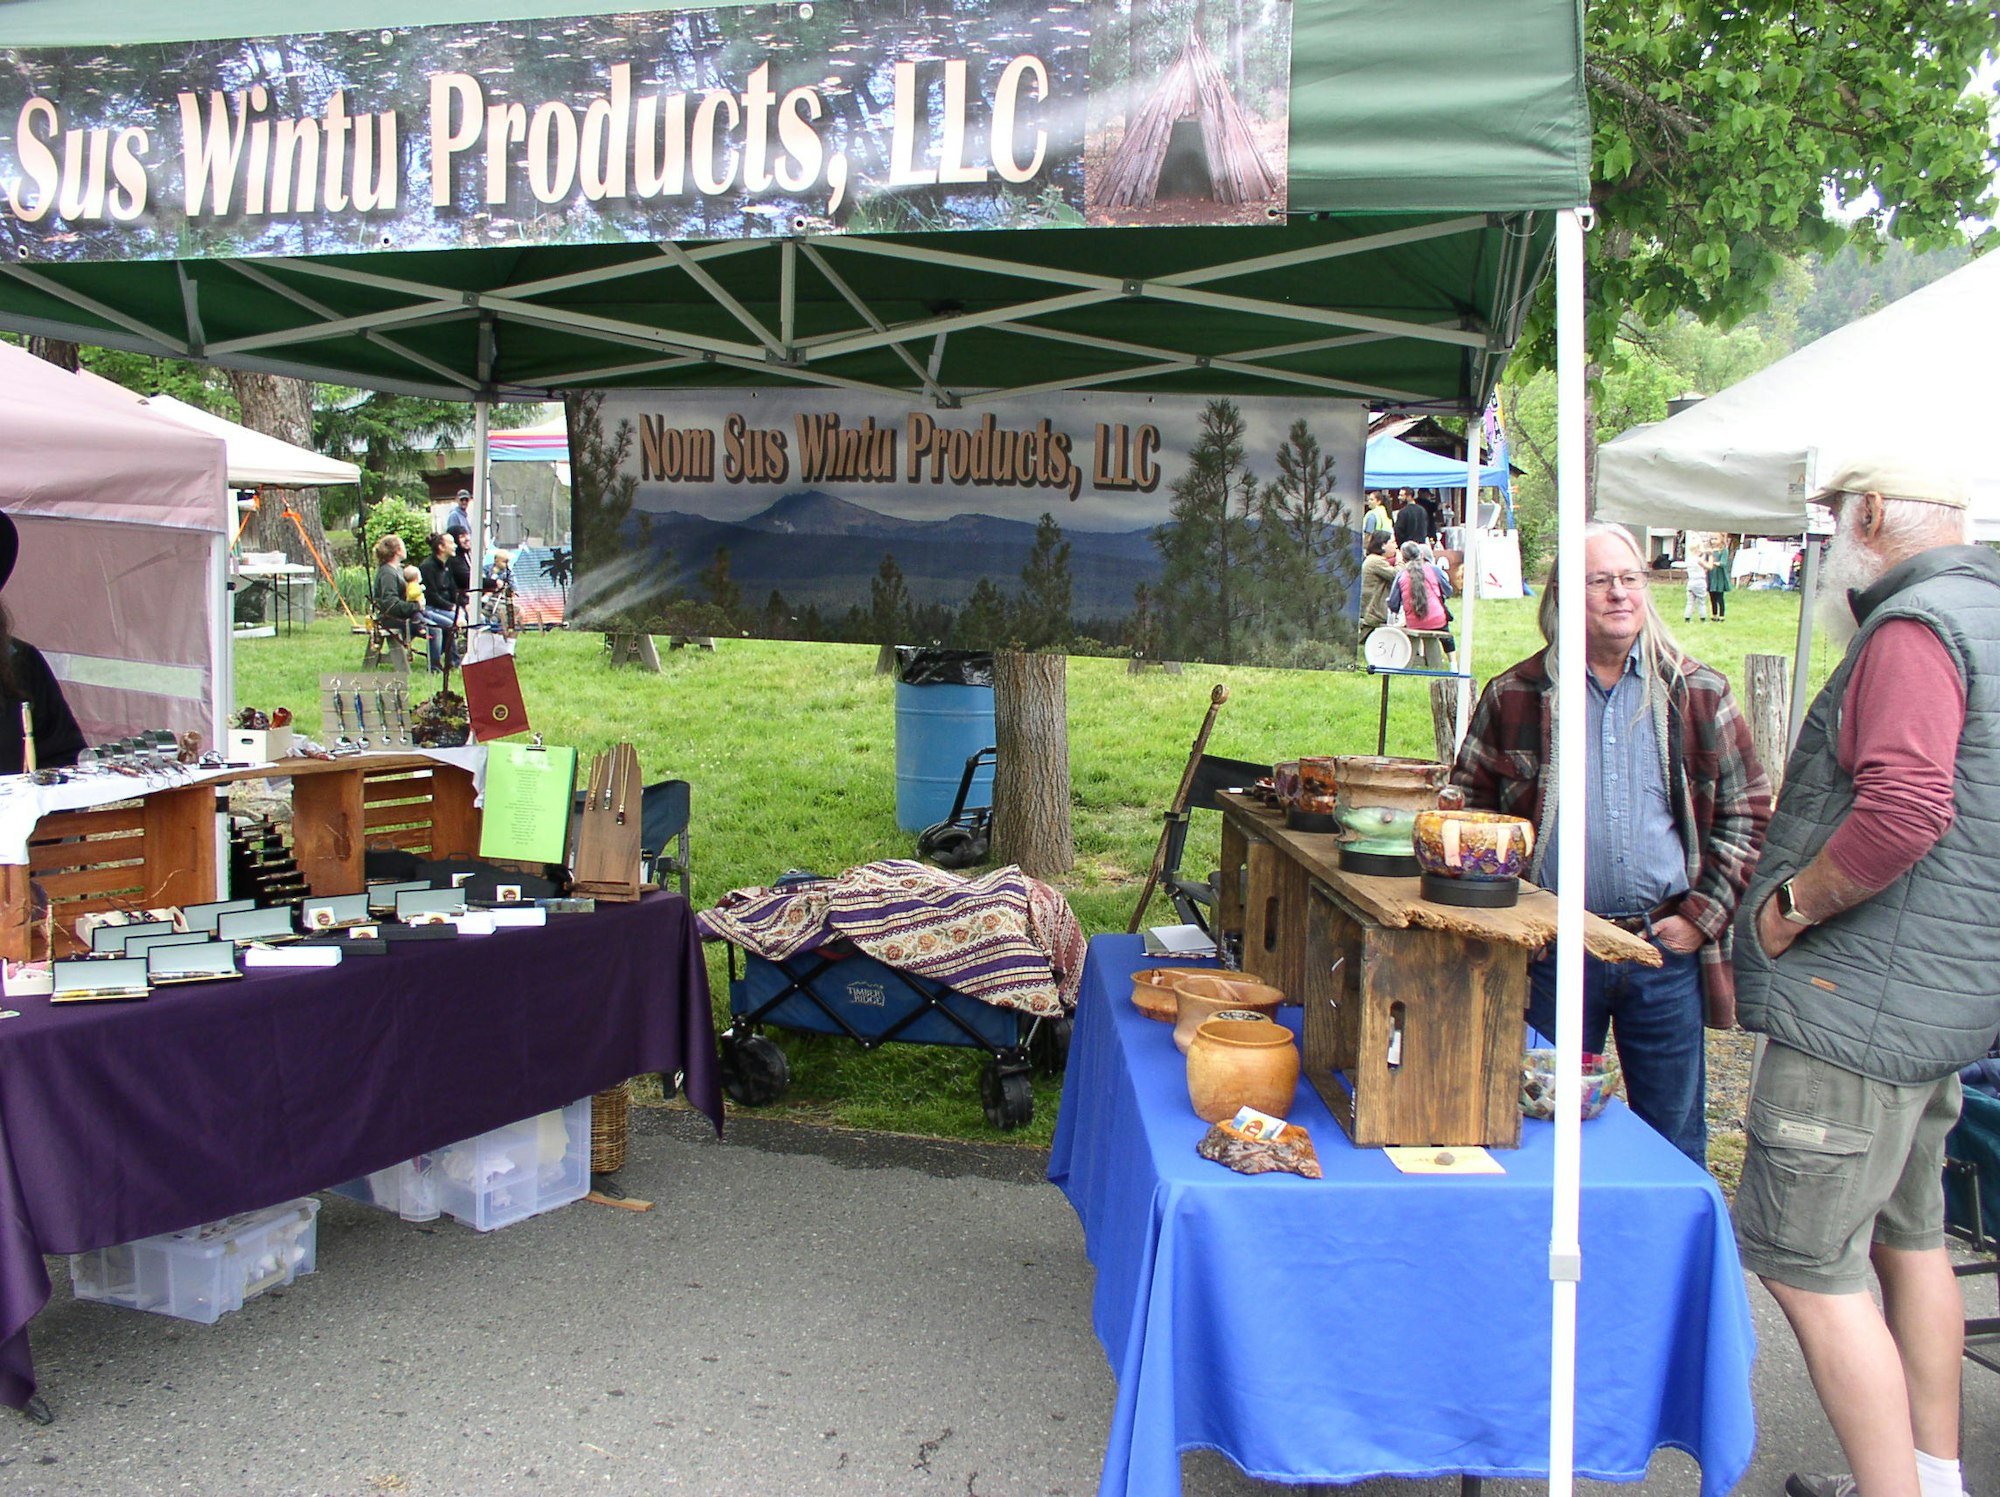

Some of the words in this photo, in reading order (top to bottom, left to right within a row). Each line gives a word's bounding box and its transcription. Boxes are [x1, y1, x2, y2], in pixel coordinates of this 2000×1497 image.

[10, 96, 150, 222] Sus
[177, 86, 397, 217] Wintu
[430, 60, 848, 215] Products,
[889, 54, 1048, 186] LLC
[639, 413, 715, 482] Nom
[723, 411, 788, 484] Sus
[794, 411, 897, 483] Wintu
[907, 412, 1082, 501] Products,
[1093, 422, 1160, 493] LLC
[1377, 641, 1397, 658] 31
